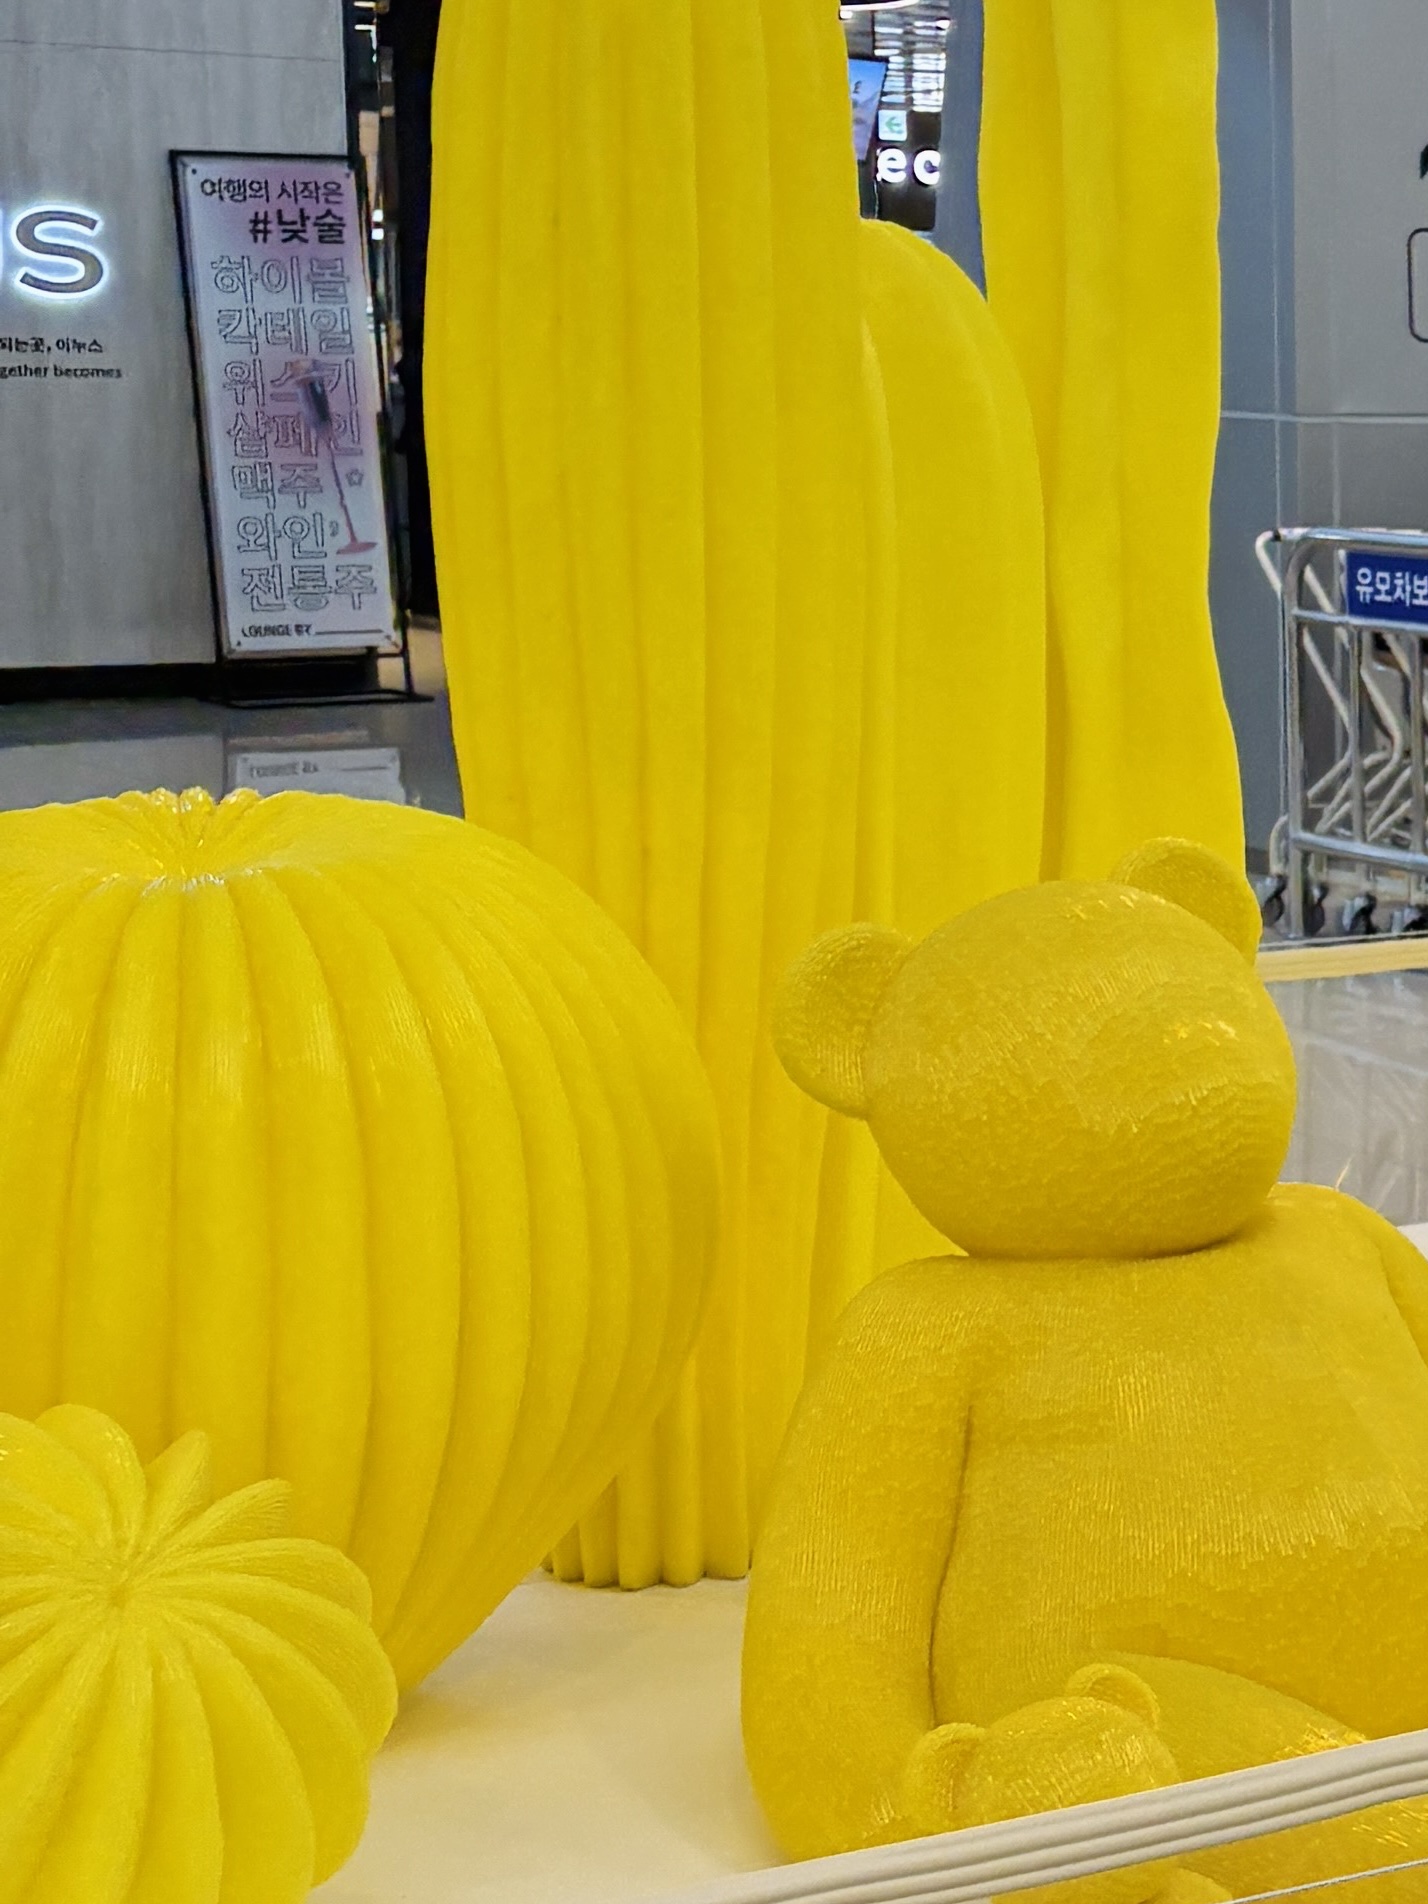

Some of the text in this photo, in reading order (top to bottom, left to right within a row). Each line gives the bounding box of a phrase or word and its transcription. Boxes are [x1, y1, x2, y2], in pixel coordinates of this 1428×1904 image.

[200, 179, 345, 205] 여행의 시작은
[248, 209, 347, 245] #낮술
[211, 256, 349, 304] 하이볼
[217, 307, 354, 356] 칵테일
[53, 364, 122, 380] becomes
[232, 462, 323, 509] 맥주
[237, 512, 327, 561] 와인
[242, 564, 377, 611] 전통주
